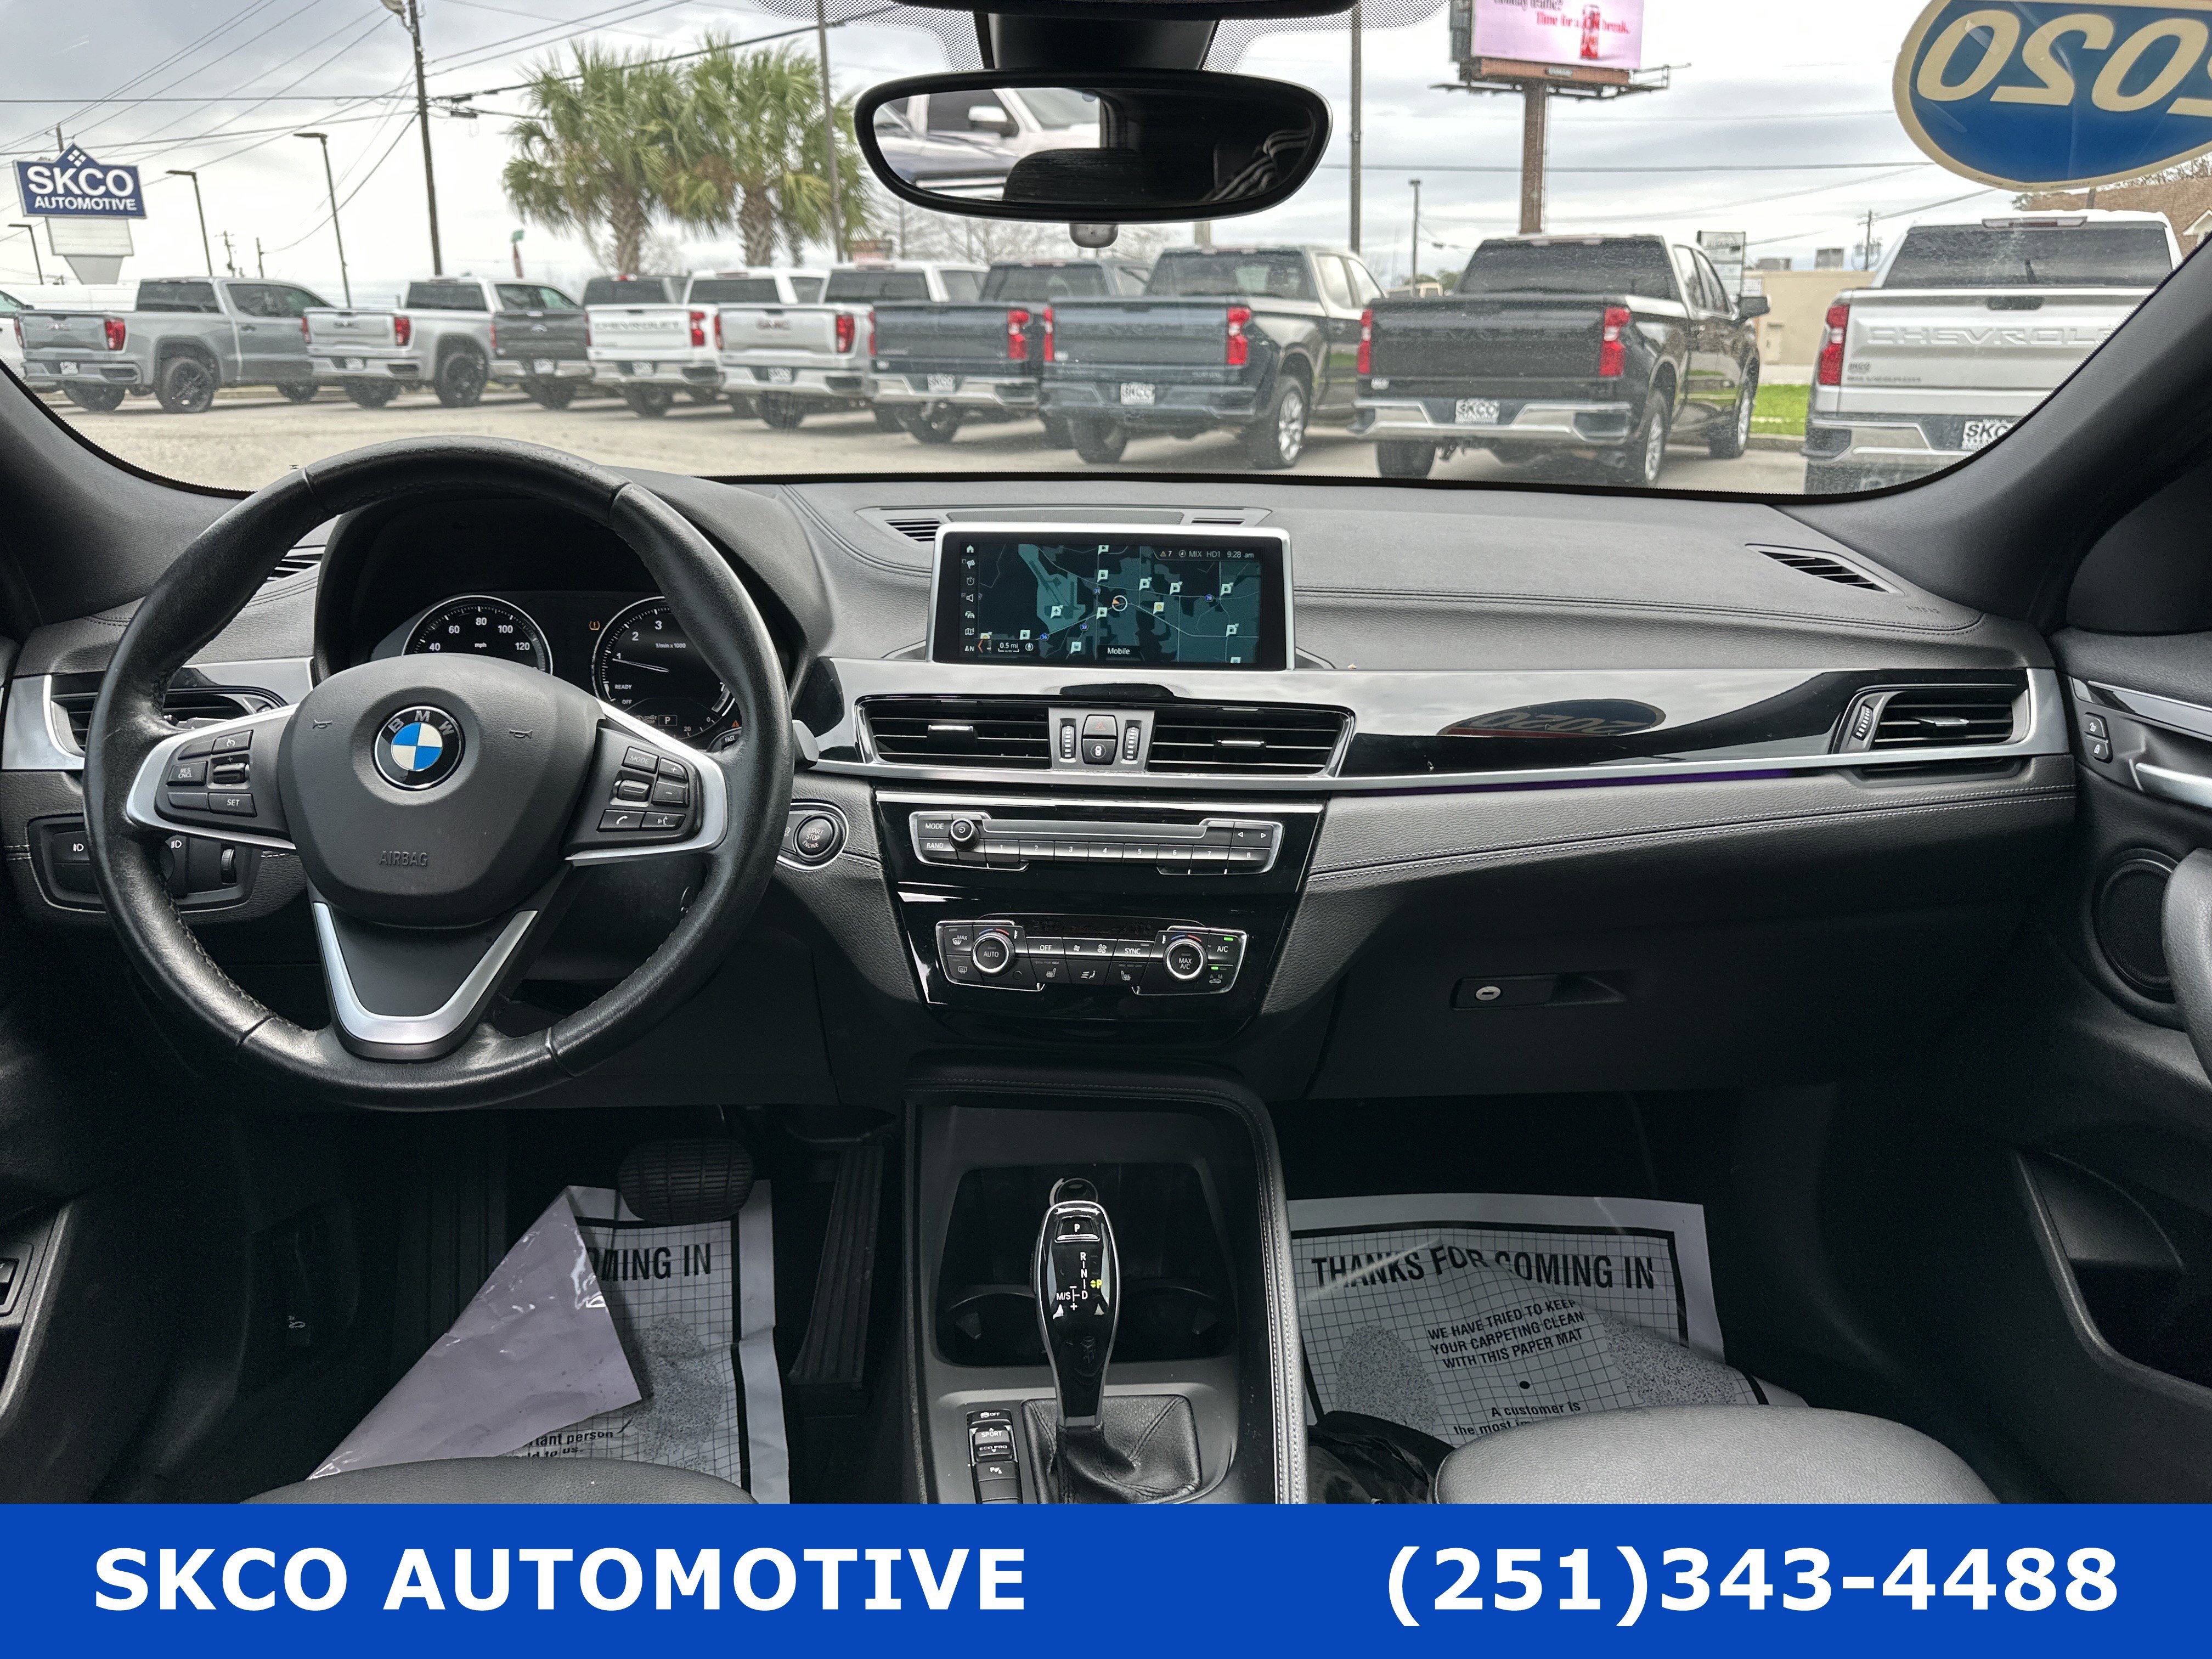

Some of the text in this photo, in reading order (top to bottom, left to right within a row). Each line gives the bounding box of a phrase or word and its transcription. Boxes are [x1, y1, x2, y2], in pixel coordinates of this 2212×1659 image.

[27, 165, 134, 198] SKCO
[34, 196, 137, 211] AUTOMOTIVE
[475, 617, 487, 626] 80
[654, 620, 663, 630] 3
[448, 625, 460, 634] 60
[498, 625, 514, 634] 100
[631, 631, 639, 641] 2
[429, 642, 441, 651] 40
[515, 642, 531, 651] 120
[387, 710, 455, 736] BMW
[724, 735, 736, 743] FAST
[630, 755, 649, 765] MODE
[806, 827, 824, 835] START
[378, 850, 429, 866] AIRBAG
[1074, 1223, 1080, 1233] P
[684, 1243, 711, 1277] IN
[1080, 1251, 1086, 1261] R
[1311, 1244, 1654, 1289] THANKS FOR COMING IN
[1081, 1268, 1087, 1278] N
[1096, 1279, 1102, 1289] P
[1056, 1291, 1071, 1301] M/S
[1081, 1290, 1088, 1300] D
[1427, 1299, 1576, 1340] WE HAVE TRIED TO KEEP
[1431, 1311, 1585, 1355] YOUR CARPETING CLEAN
[1442, 1328, 1583, 1369] WITH THIS PAPER MAT
[1491, 1401, 1581, 1417] A customer is
[1453, 1425, 1475, 1435] the
[1480, 1420, 1512, 1435] most
[566, 1431, 613, 1445] person
